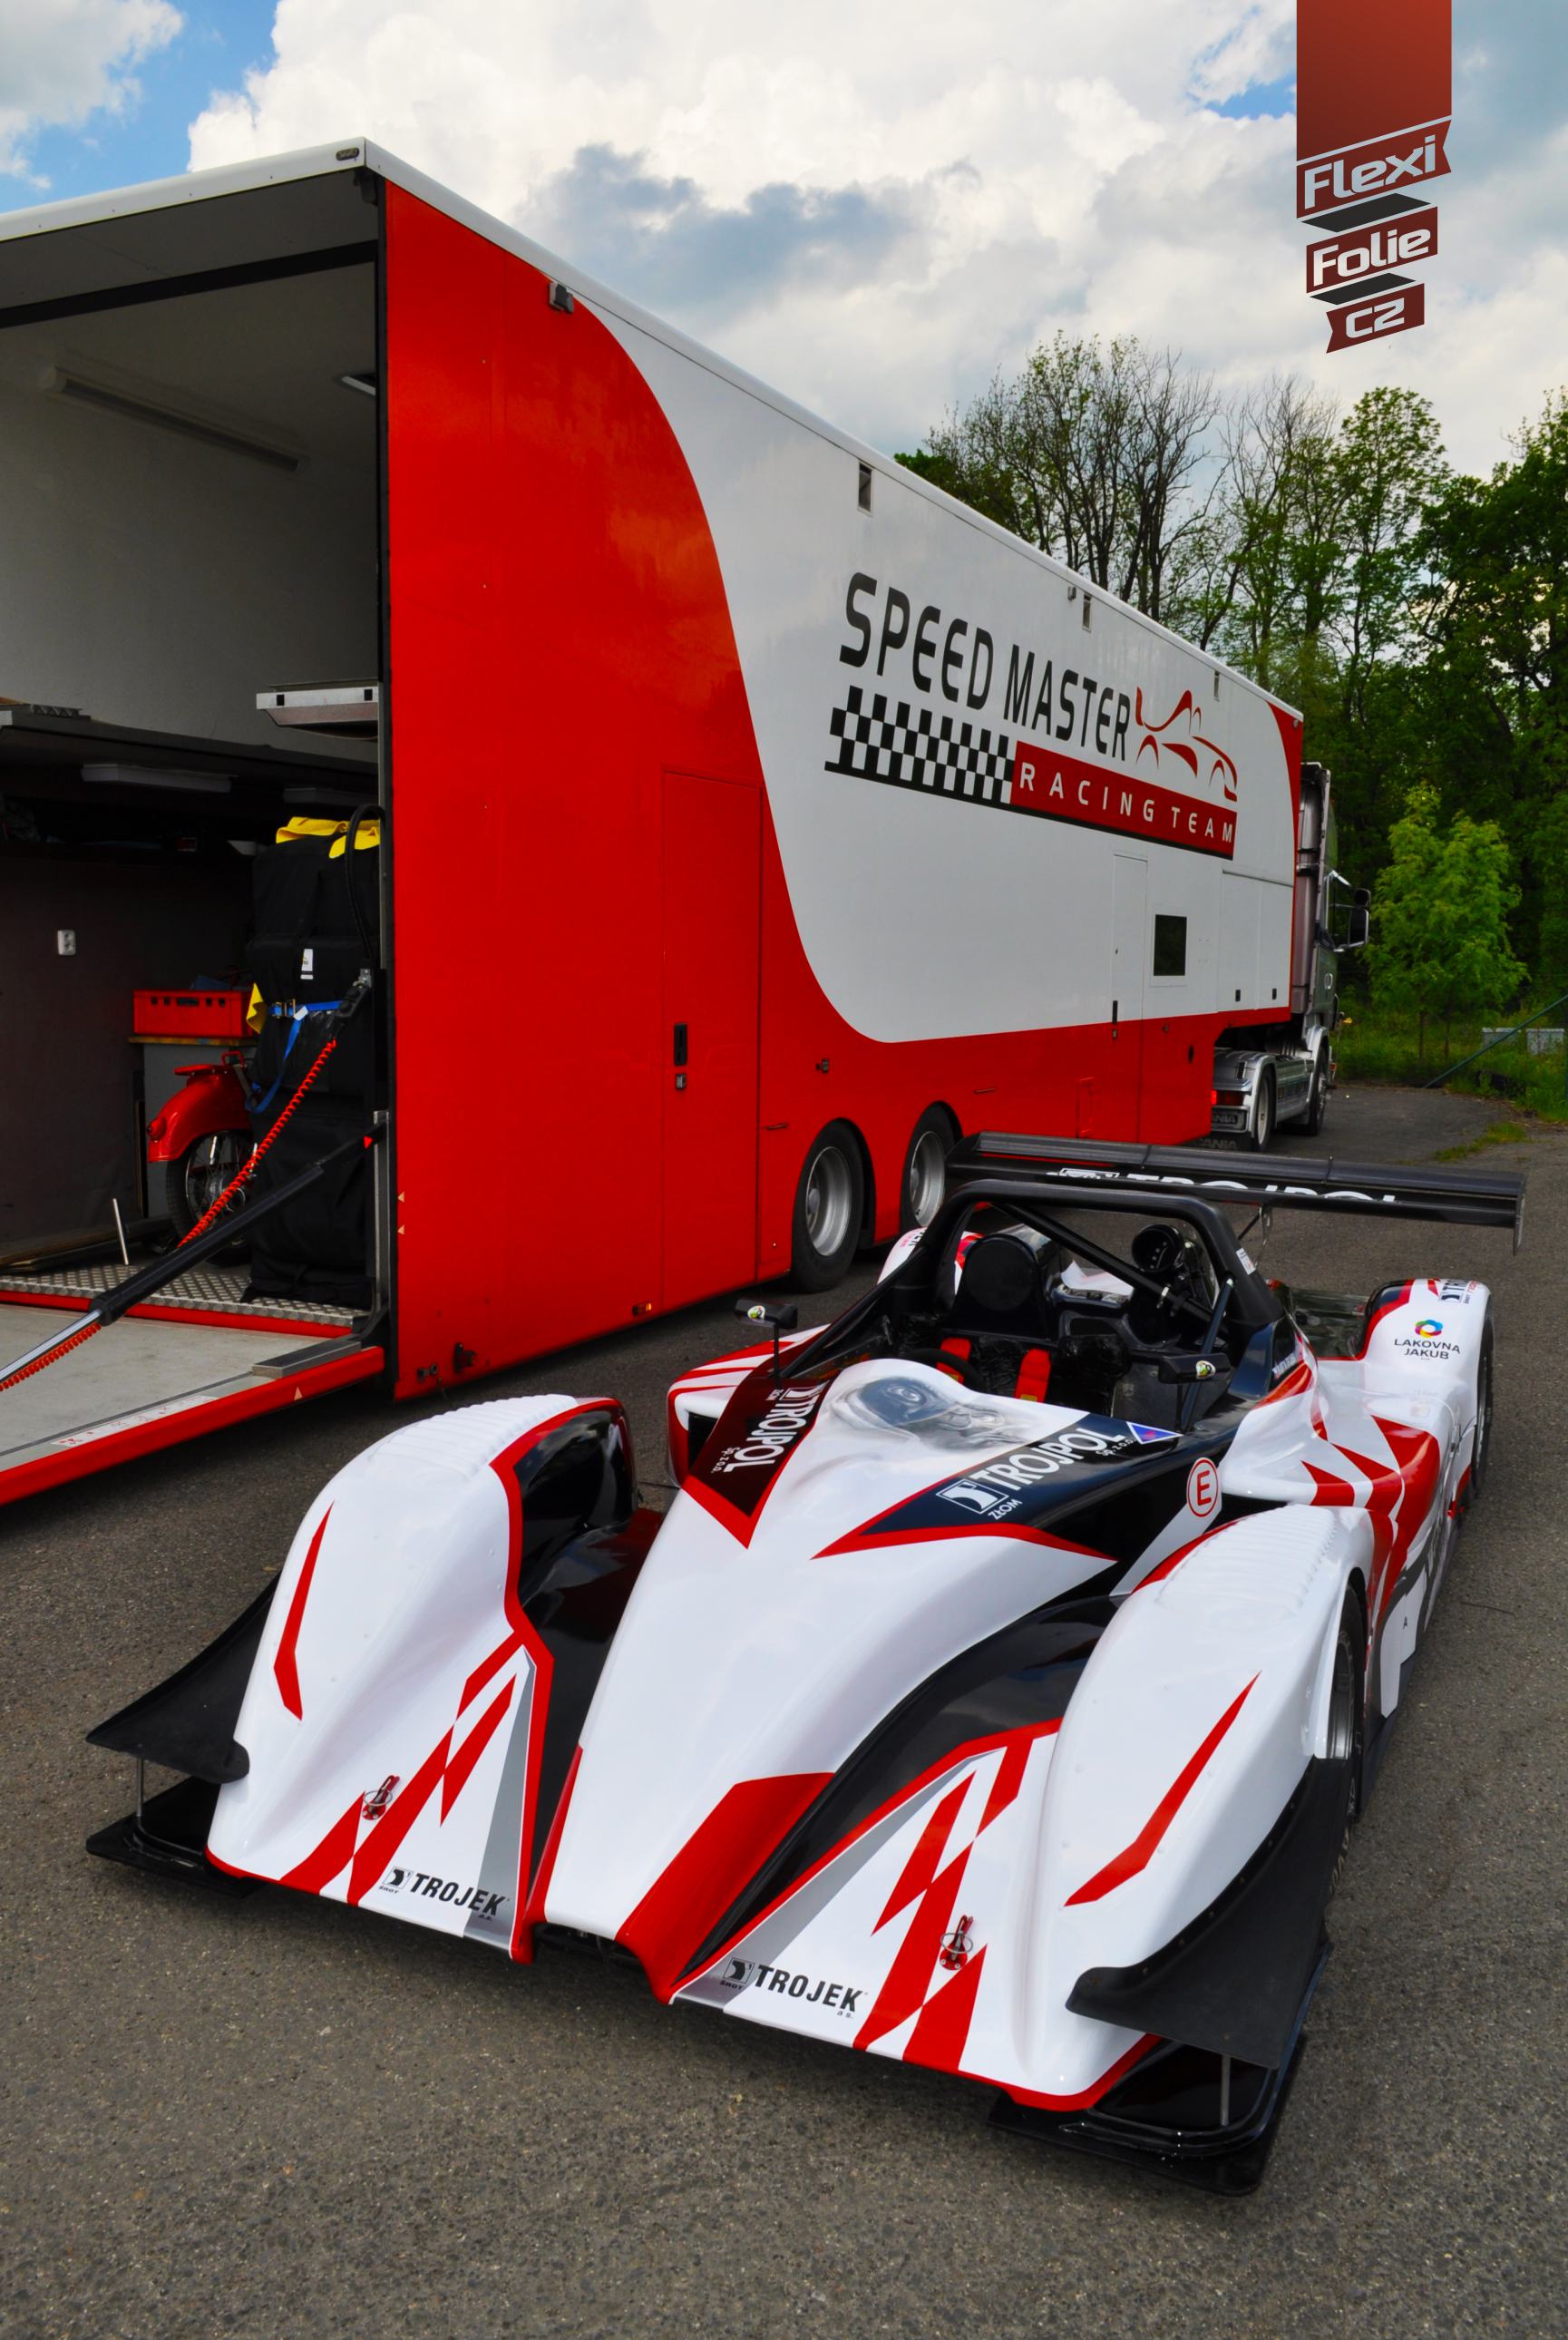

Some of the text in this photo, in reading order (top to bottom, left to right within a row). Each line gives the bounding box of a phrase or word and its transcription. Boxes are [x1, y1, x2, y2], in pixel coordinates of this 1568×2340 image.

[839, 571, 1131, 761] SPEED MASTER
[1019, 763, 1232, 843] RACING TEAM
[1394, 1339, 1461, 1354] LAKOVNA
[1404, 1348, 1449, 1360] JAKUB
[723, 1394, 820, 1473] TROJPOL
[969, 1428, 1125, 1491] TROJPOL
[1197, 1469, 1212, 1506] E
[411, 1873, 505, 1916] TROJEK
[755, 1965, 863, 2012] TROJEK
